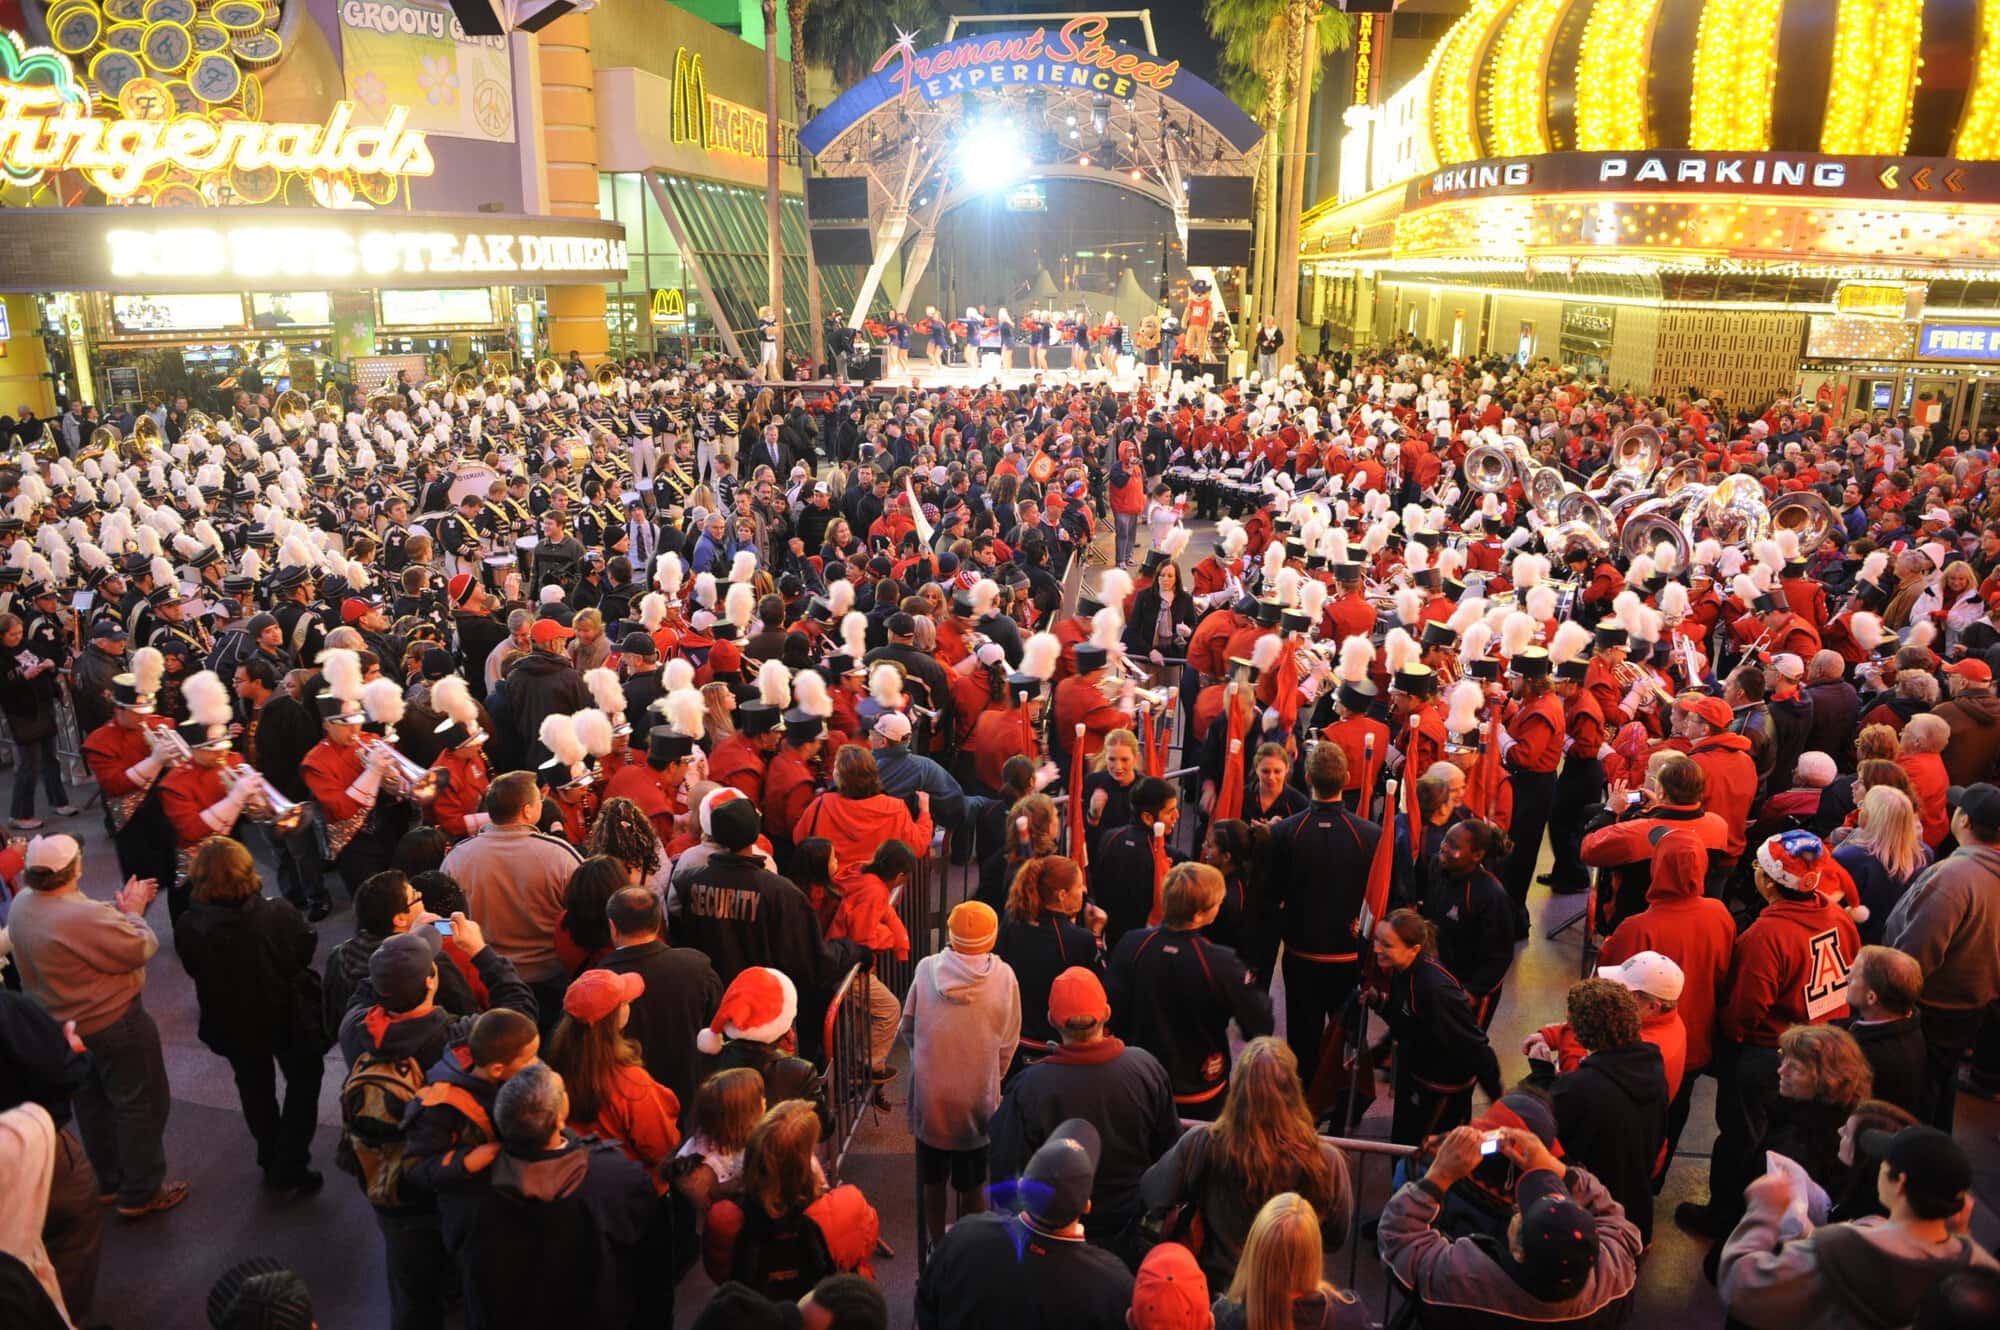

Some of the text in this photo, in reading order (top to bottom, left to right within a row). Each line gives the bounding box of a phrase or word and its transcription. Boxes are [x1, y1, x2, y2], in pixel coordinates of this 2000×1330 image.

[343, 1, 444, 39] GROOVY
[872, 15, 1180, 106] Fremont Street
[1355, 14, 1373, 104] NTRANCE
[927, 62, 1132, 97] EXPERIENCE
[1600, 159, 1846, 188] PARKING
[1928, 330, 1986, 351] FREE
[690, 883, 761, 922] SECURITY
[1804, 927, 1850, 1003] A
